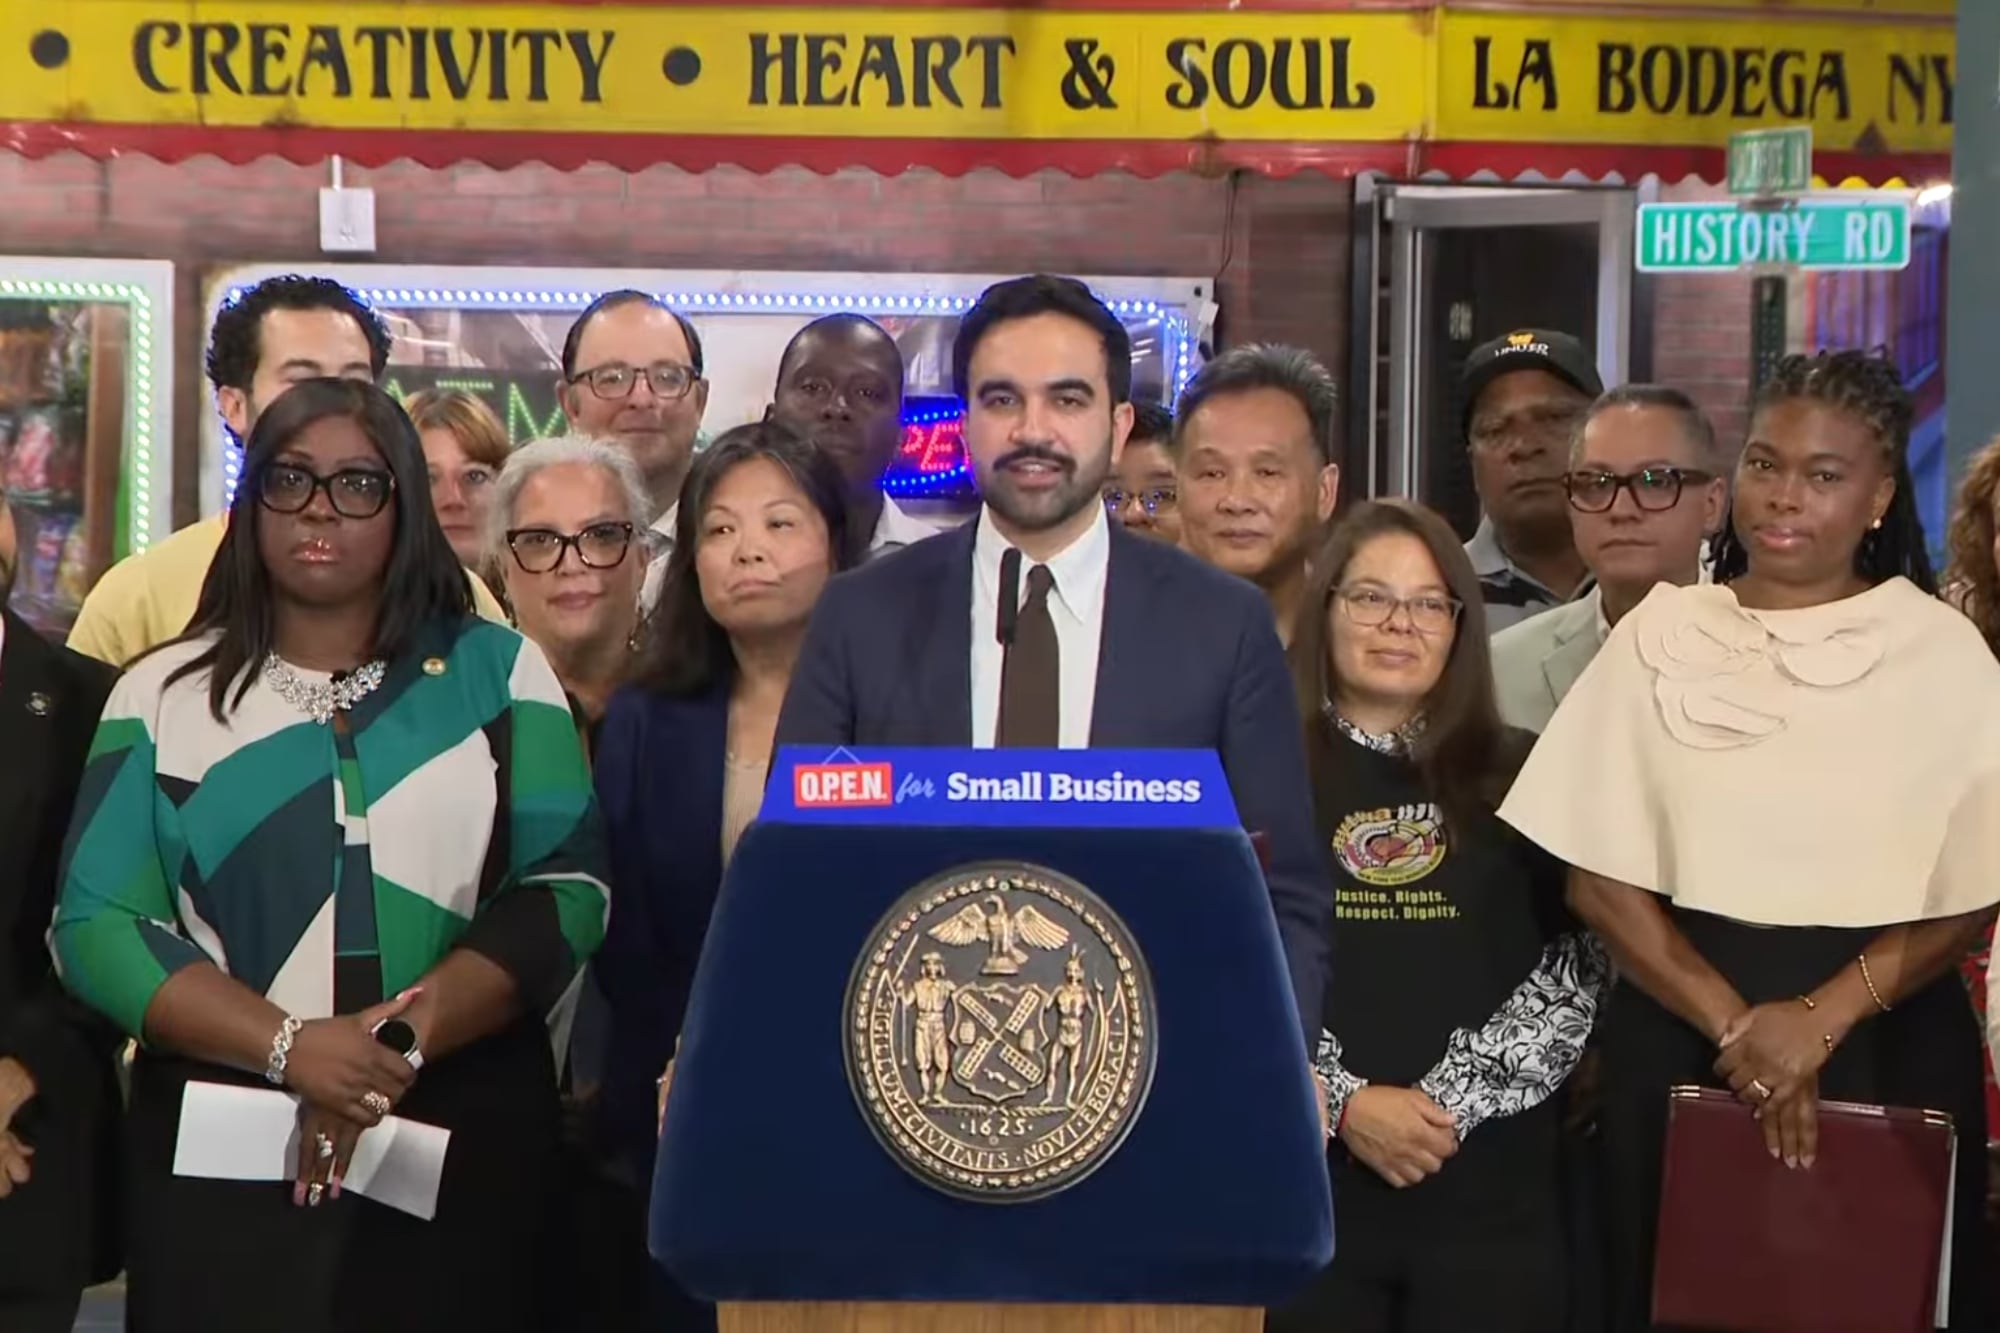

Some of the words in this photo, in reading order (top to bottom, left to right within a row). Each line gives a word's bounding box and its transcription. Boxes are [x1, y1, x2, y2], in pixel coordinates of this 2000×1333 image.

[134, 21, 615, 103] CREATIVITY
[748, 33, 1015, 109] HEART
[1061, 39, 1117, 110] &
[1165, 38, 1375, 110] SOUL
[1473, 37, 1558, 110] LA
[1598, 43, 1850, 120] BODEGA
[1654, 211, 1816, 263] HISTORY
[1844, 211, 1895, 261] RD
[800, 771, 888, 802] O.P.E.N.
[895, 772, 936, 804] for
[947, 771, 1043, 801] Small
[1049, 771, 1201, 803] Business
[1336, 889, 1392, 904] Justice.
[1395, 890, 1448, 905] Rights.
[1336, 905, 1400, 921] Respect.
[1403, 904, 1460, 921] Dignity.
